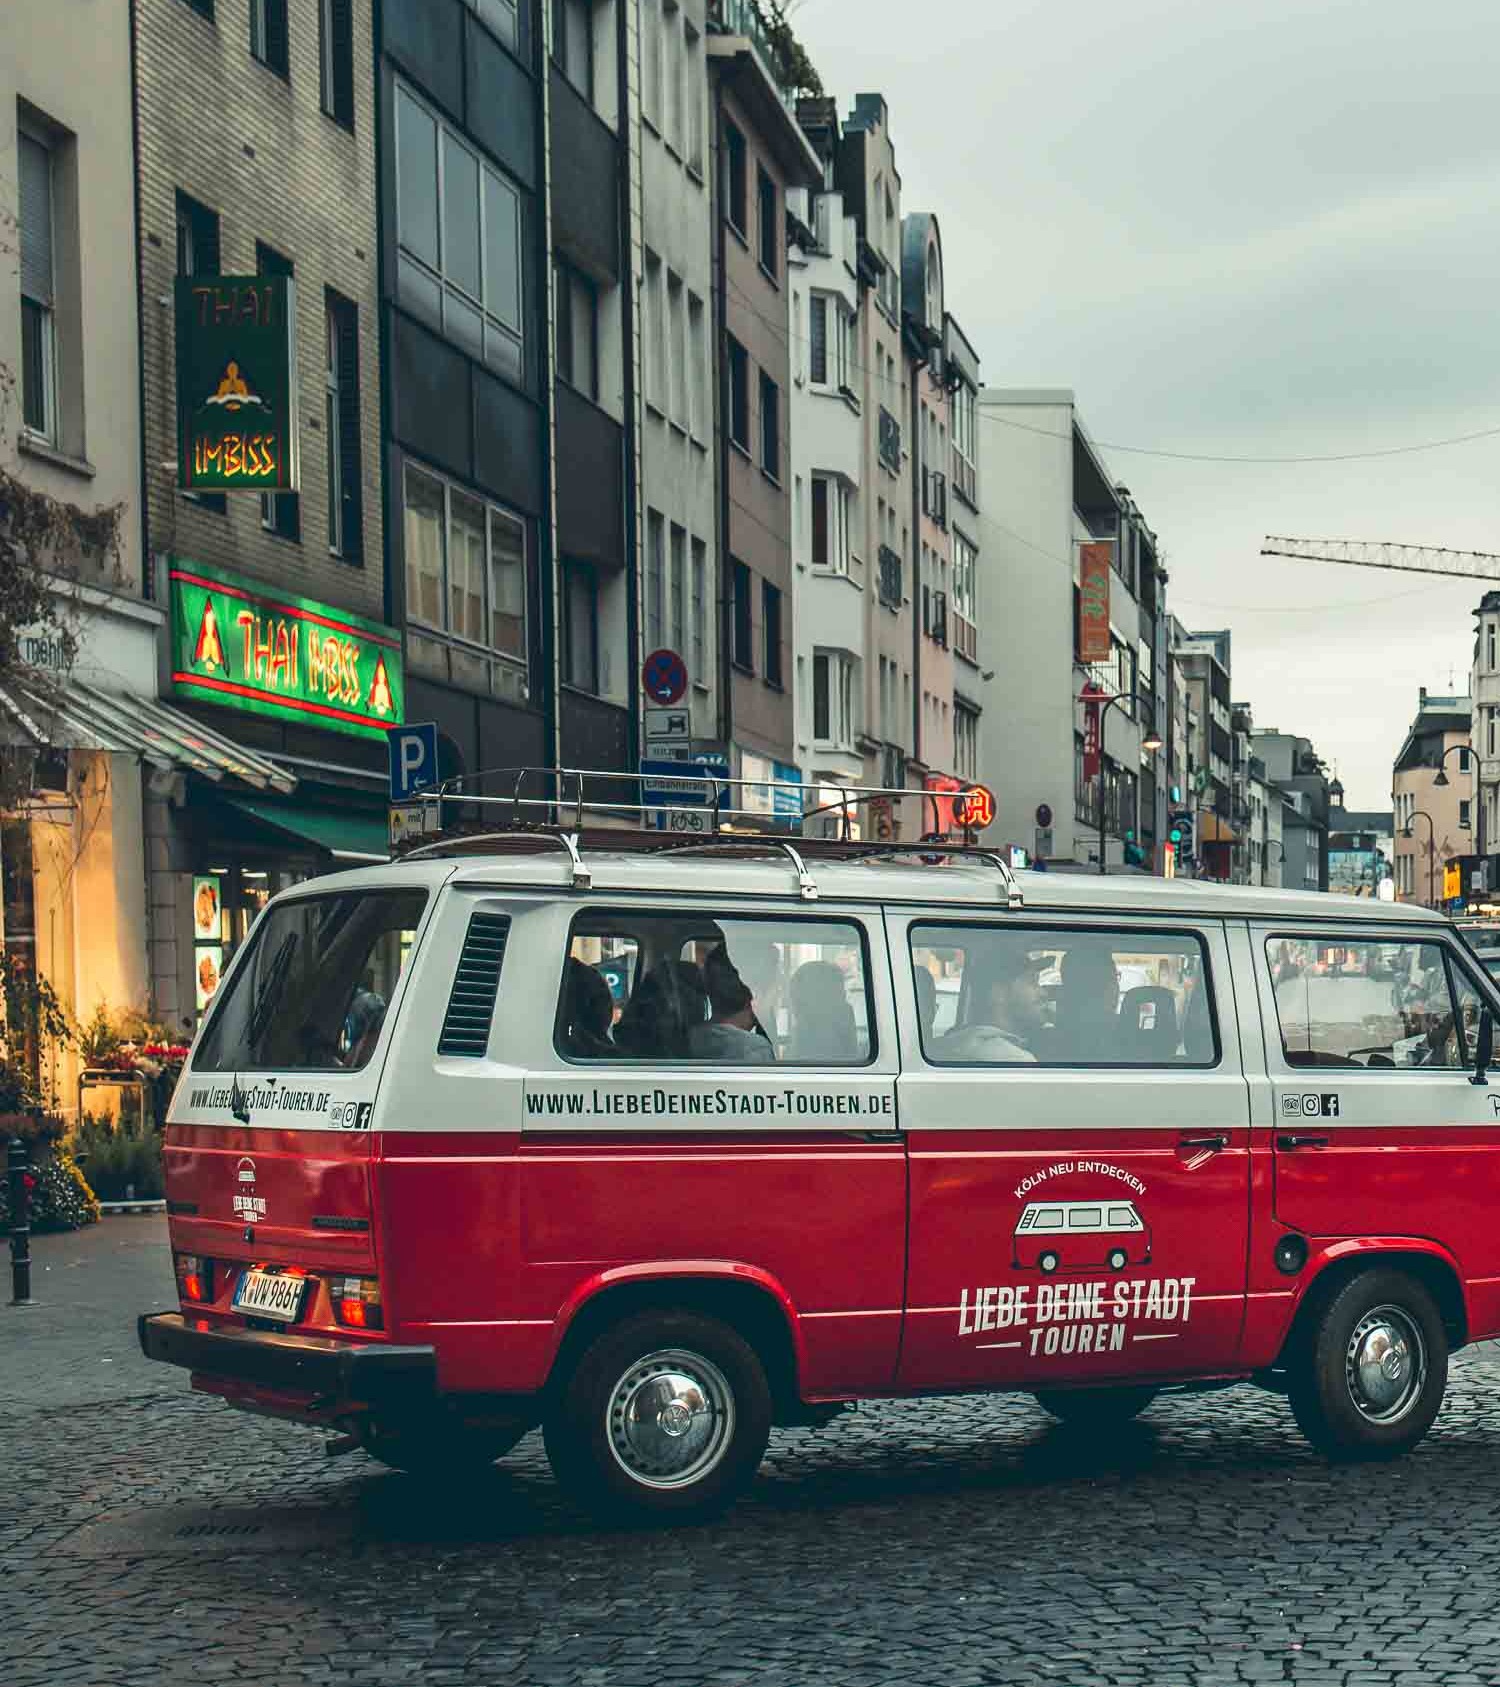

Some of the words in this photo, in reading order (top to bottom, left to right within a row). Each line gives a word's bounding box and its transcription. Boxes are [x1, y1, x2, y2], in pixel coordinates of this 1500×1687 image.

[191, 286, 273, 327] THAI
[194, 434, 277, 477] IMBISS
[238, 611, 298, 687] THAI
[307, 634, 361, 706] IMBISS
[401, 735, 425, 791] P
[1014, 1169, 1047, 1199] KÖLN
[1048, 1162, 1075, 1177] NEU
[1077, 1161, 1147, 1196] ENTDECKEN
[958, 1285, 1030, 1336] LIEBE
[1036, 1281, 1107, 1324] DEINE
[1113, 1277, 1196, 1322] STADT
[1029, 1323, 1126, 1357] TOUREN
